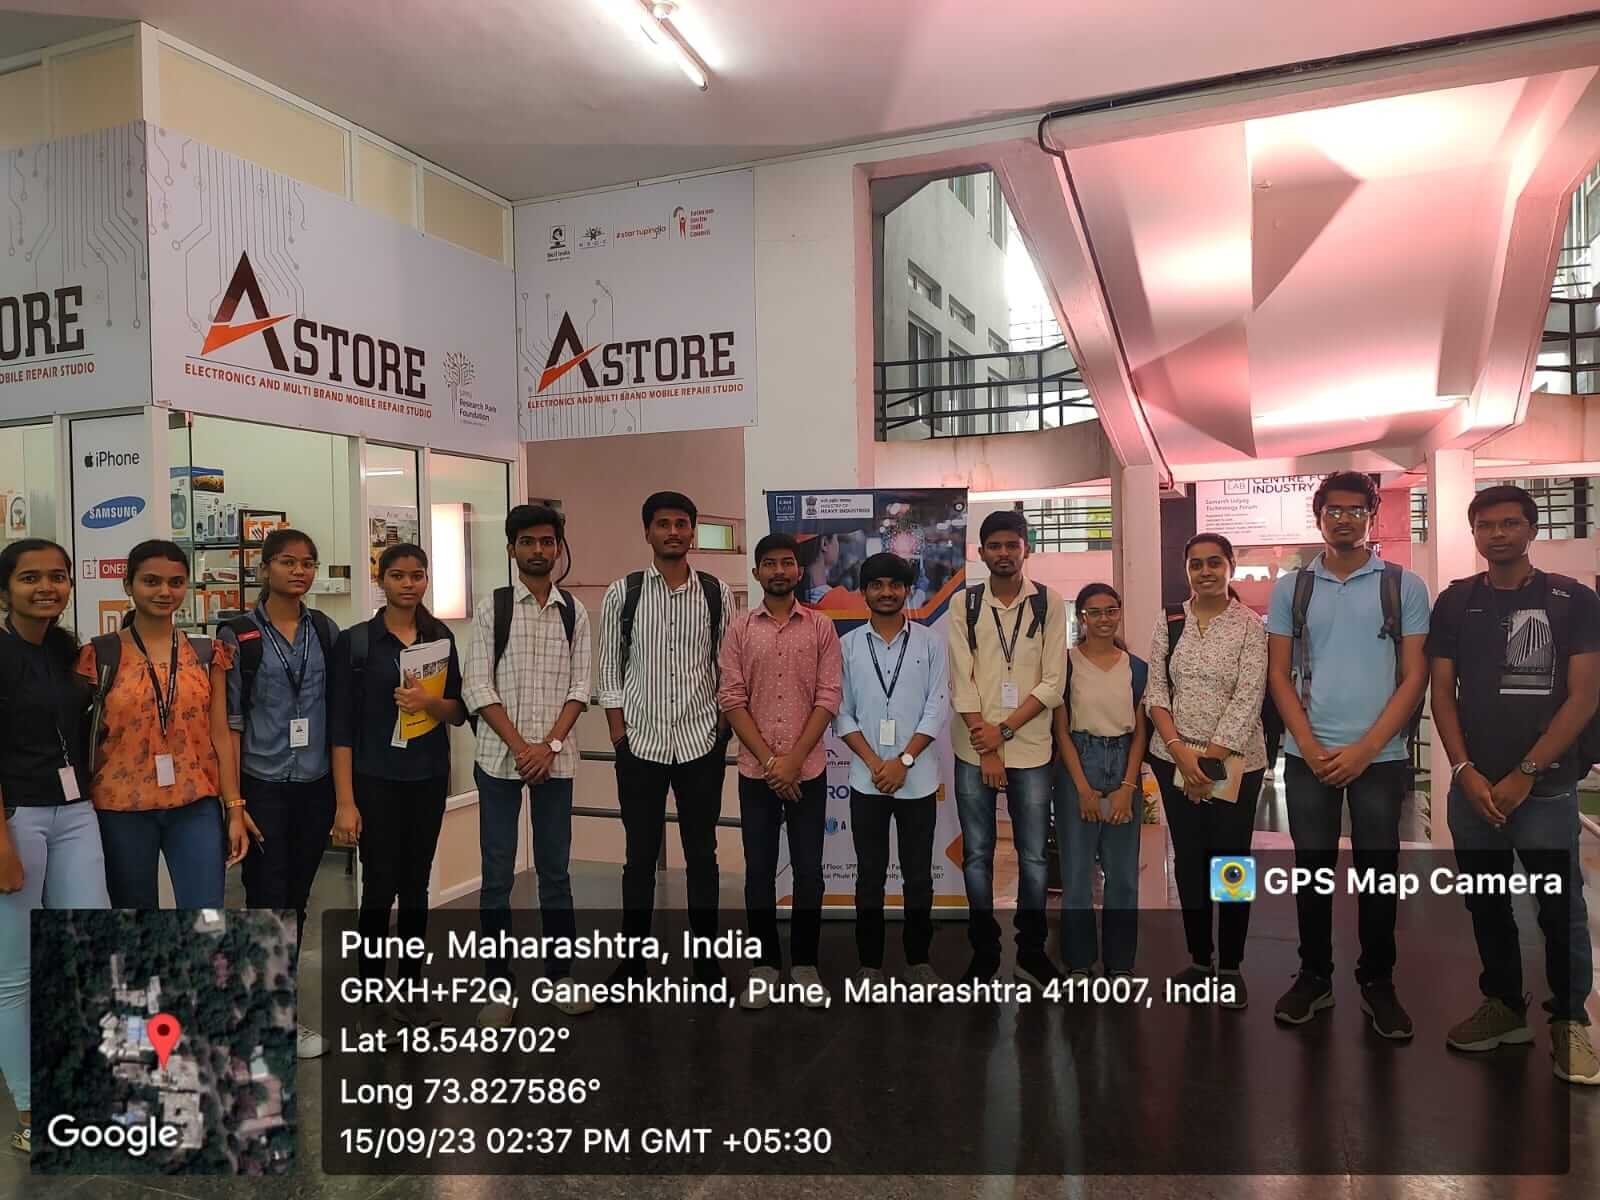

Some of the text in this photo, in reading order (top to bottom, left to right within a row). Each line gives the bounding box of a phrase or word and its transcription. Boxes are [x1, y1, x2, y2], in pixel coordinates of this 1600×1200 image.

[25, 366, 58, 381] REPAIR
[60, 361, 96, 377] STUDIO
[184, 363, 433, 419] ELECTRONICS AND MULTI BRAND MOBILE REPAIR STUDIO
[527, 383, 745, 409] ELECTRONICS AND MULTI BRAND MOBILE REPAIR STUDIO
[96, 451, 140, 468] iPhone
[1252, 483, 1315, 494] INDUSTRY
[89, 506, 138, 520] SAMSUNG
